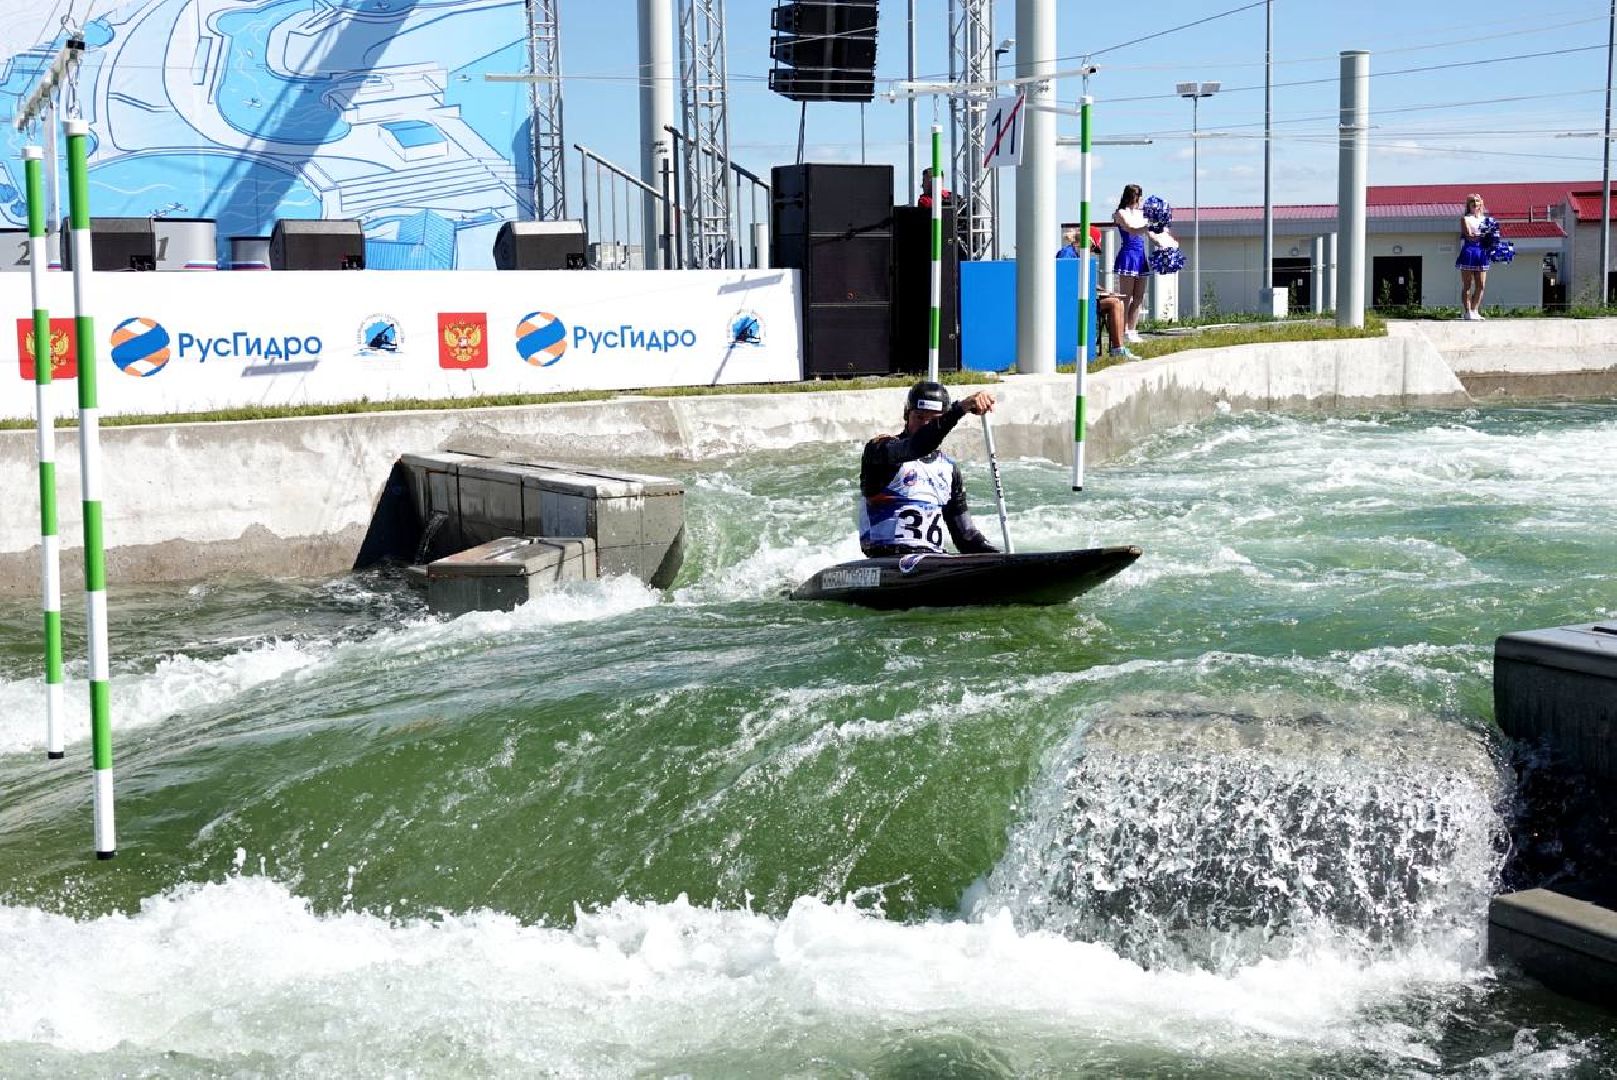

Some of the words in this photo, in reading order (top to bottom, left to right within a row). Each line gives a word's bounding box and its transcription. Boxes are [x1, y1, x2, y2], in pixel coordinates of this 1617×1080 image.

[992, 107, 1016, 156] 11
[13, 240, 31, 265] 2
[157, 236, 169, 261] 1
[178, 331, 323, 363] РусГидро
[572, 324, 697, 353] РусГидро
[895, 509, 943, 546] 36
